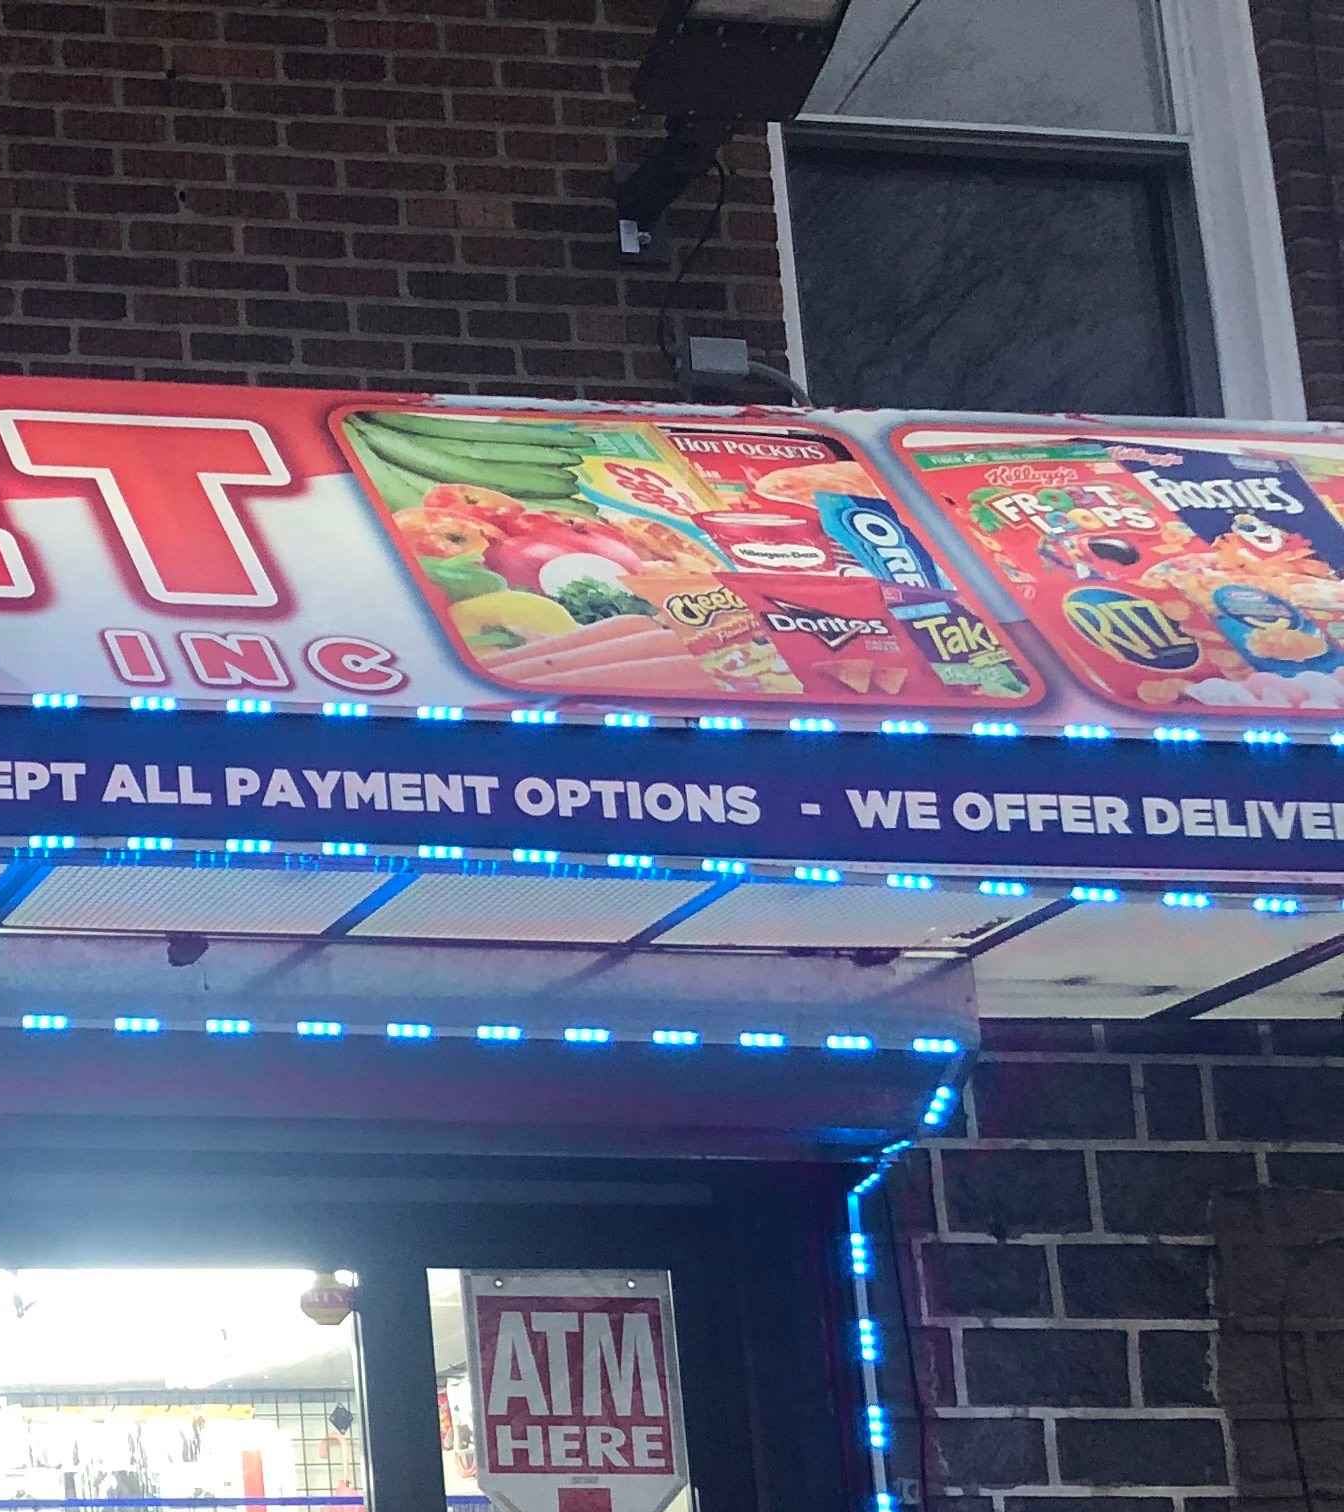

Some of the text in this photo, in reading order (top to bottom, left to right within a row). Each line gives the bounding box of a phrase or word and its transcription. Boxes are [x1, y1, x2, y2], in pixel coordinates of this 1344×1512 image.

[672, 436, 826, 460] HOT POCKETS
[984, 465, 1078, 487] Kellogg's
[1133, 470, 1305, 515] FROSTIES
[991, 486, 1119, 522] FROOT
[1029, 506, 1156, 535] LOOPS
[767, 613, 889, 635] Doritos
[1065, 599, 1196, 662] RITZ
[104, 629, 406, 693] INC
[102, 764, 212, 806] ALL
[226, 768, 500, 817] PAYMENT
[513, 777, 762, 826] OPTIONS
[846, 789, 941, 831] WE
[952, 792, 1133, 836] OFFER
[1144, 797, 1344, 841] DELIVE
[488, 1311, 664, 1417] ATM
[495, 1424, 666, 1468] HERE
